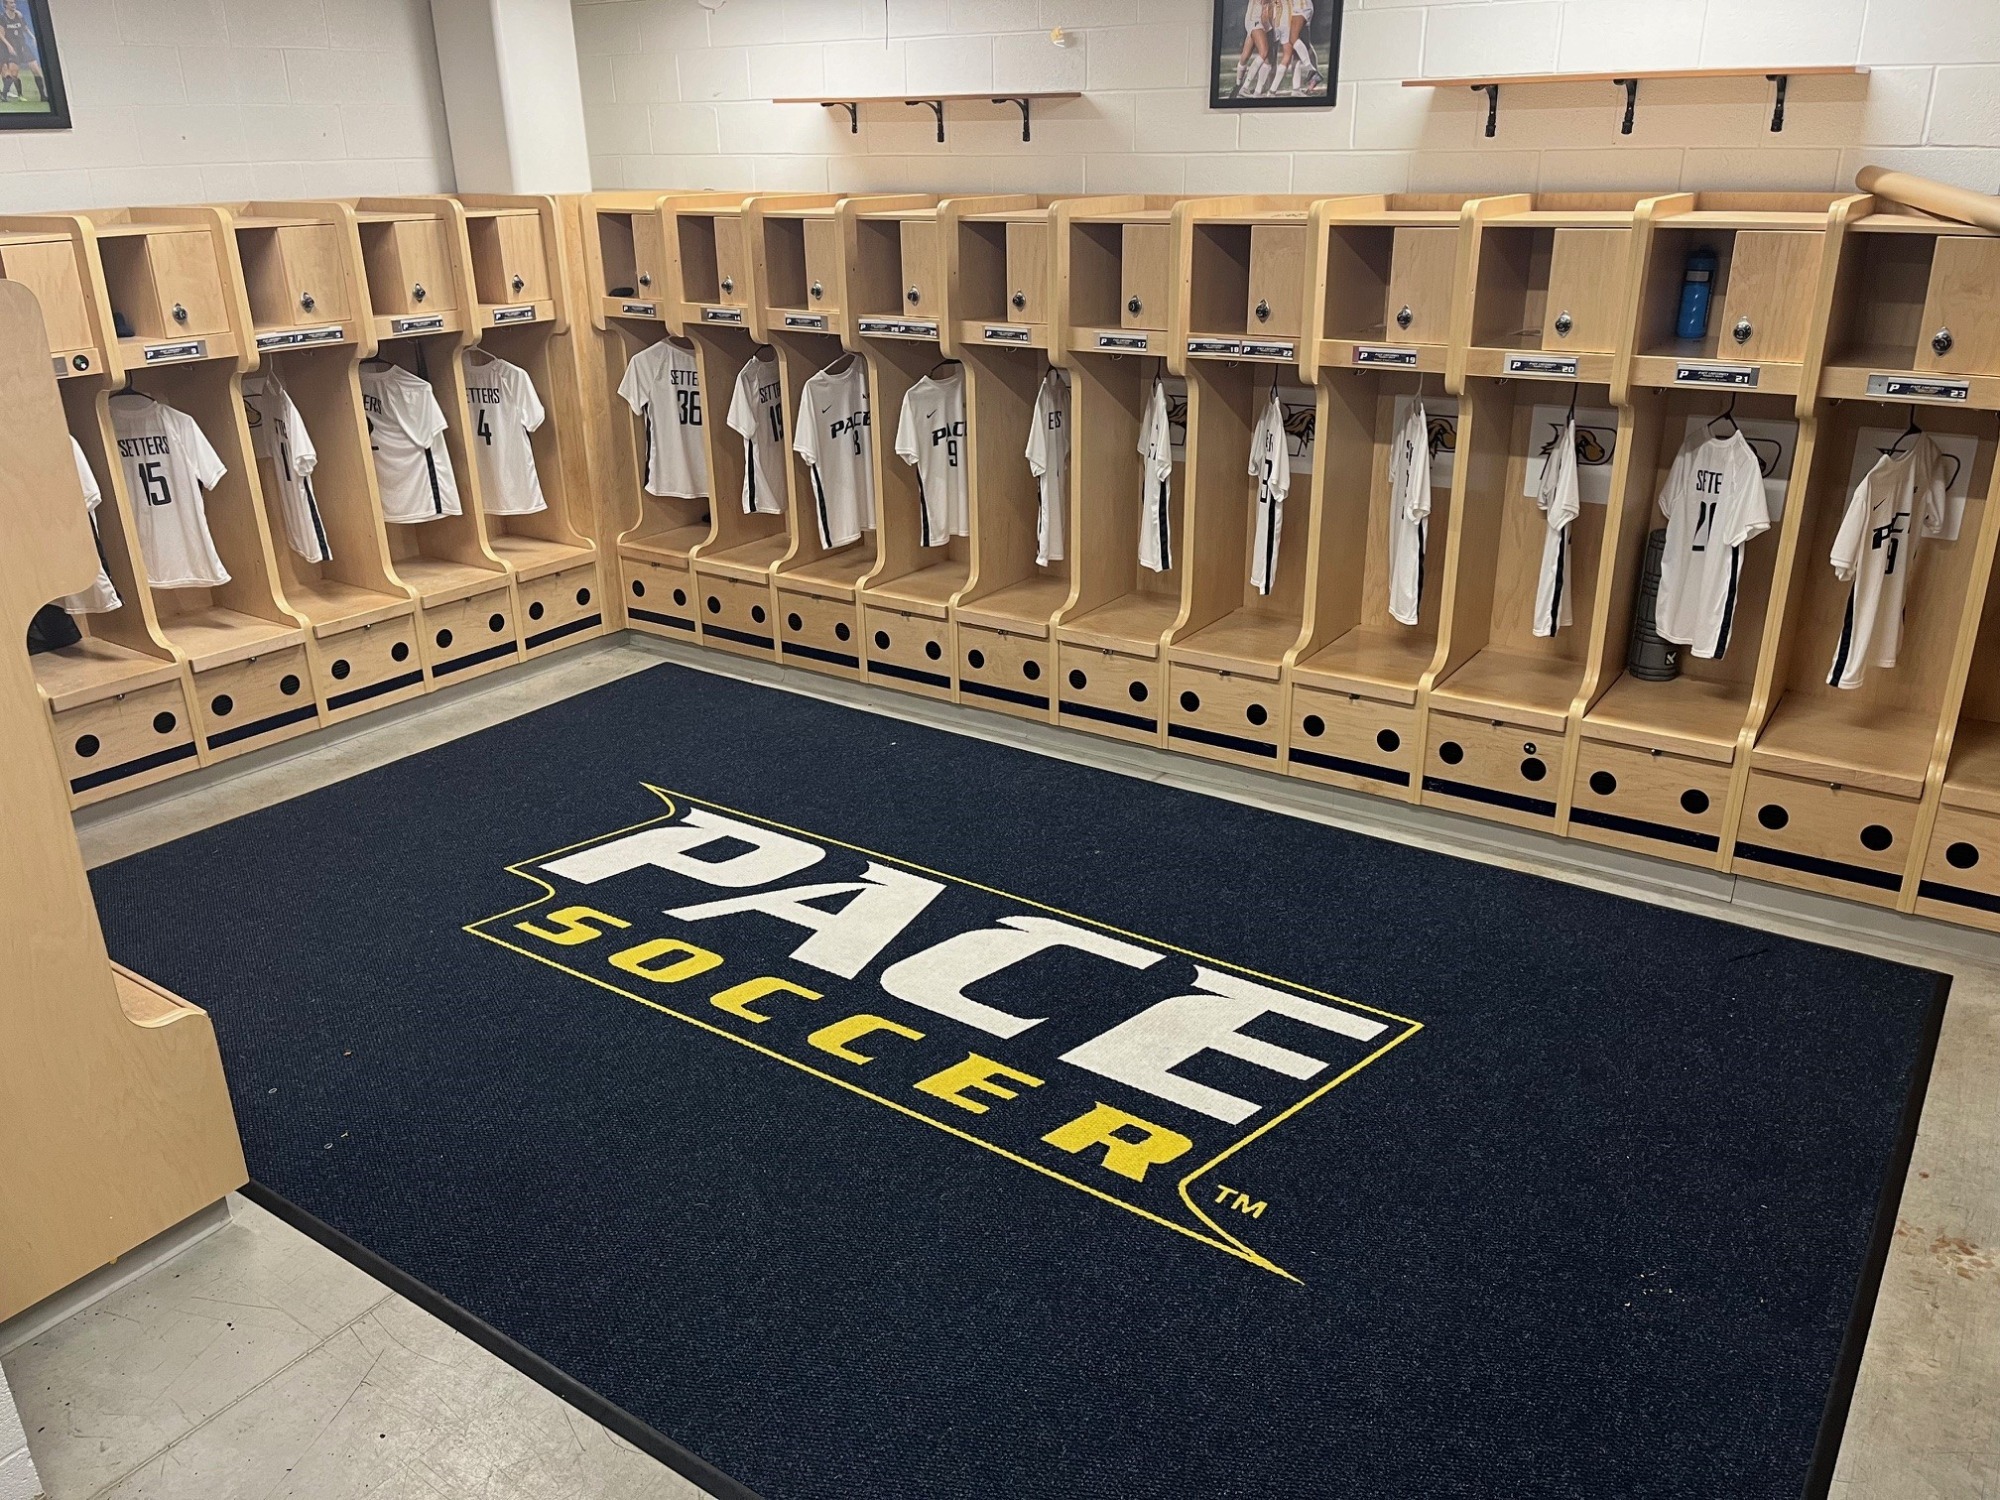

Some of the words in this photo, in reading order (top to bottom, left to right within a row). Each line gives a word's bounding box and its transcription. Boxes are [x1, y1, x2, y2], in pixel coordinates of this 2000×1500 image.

[1360, 352, 1368, 360] P
[1512, 361, 1521, 369] P
[1561, 365, 1575, 373] 20
[1679, 370, 1689, 378] P
[1735, 375, 1749, 383] 21
[1888, 383, 1900, 392] P
[1950, 389, 1966, 398] 23
[677, 390, 703, 426] 36
[477, 409, 492, 446] 4
[117, 436, 170, 458] SETTERS
[947, 440, 958, 467] 9
[138, 461, 172, 506] 15
[538, 808, 1388, 1125] PACE
[514, 906, 1193, 1183] SOCCER
[1214, 1184, 1268, 1219] TM
